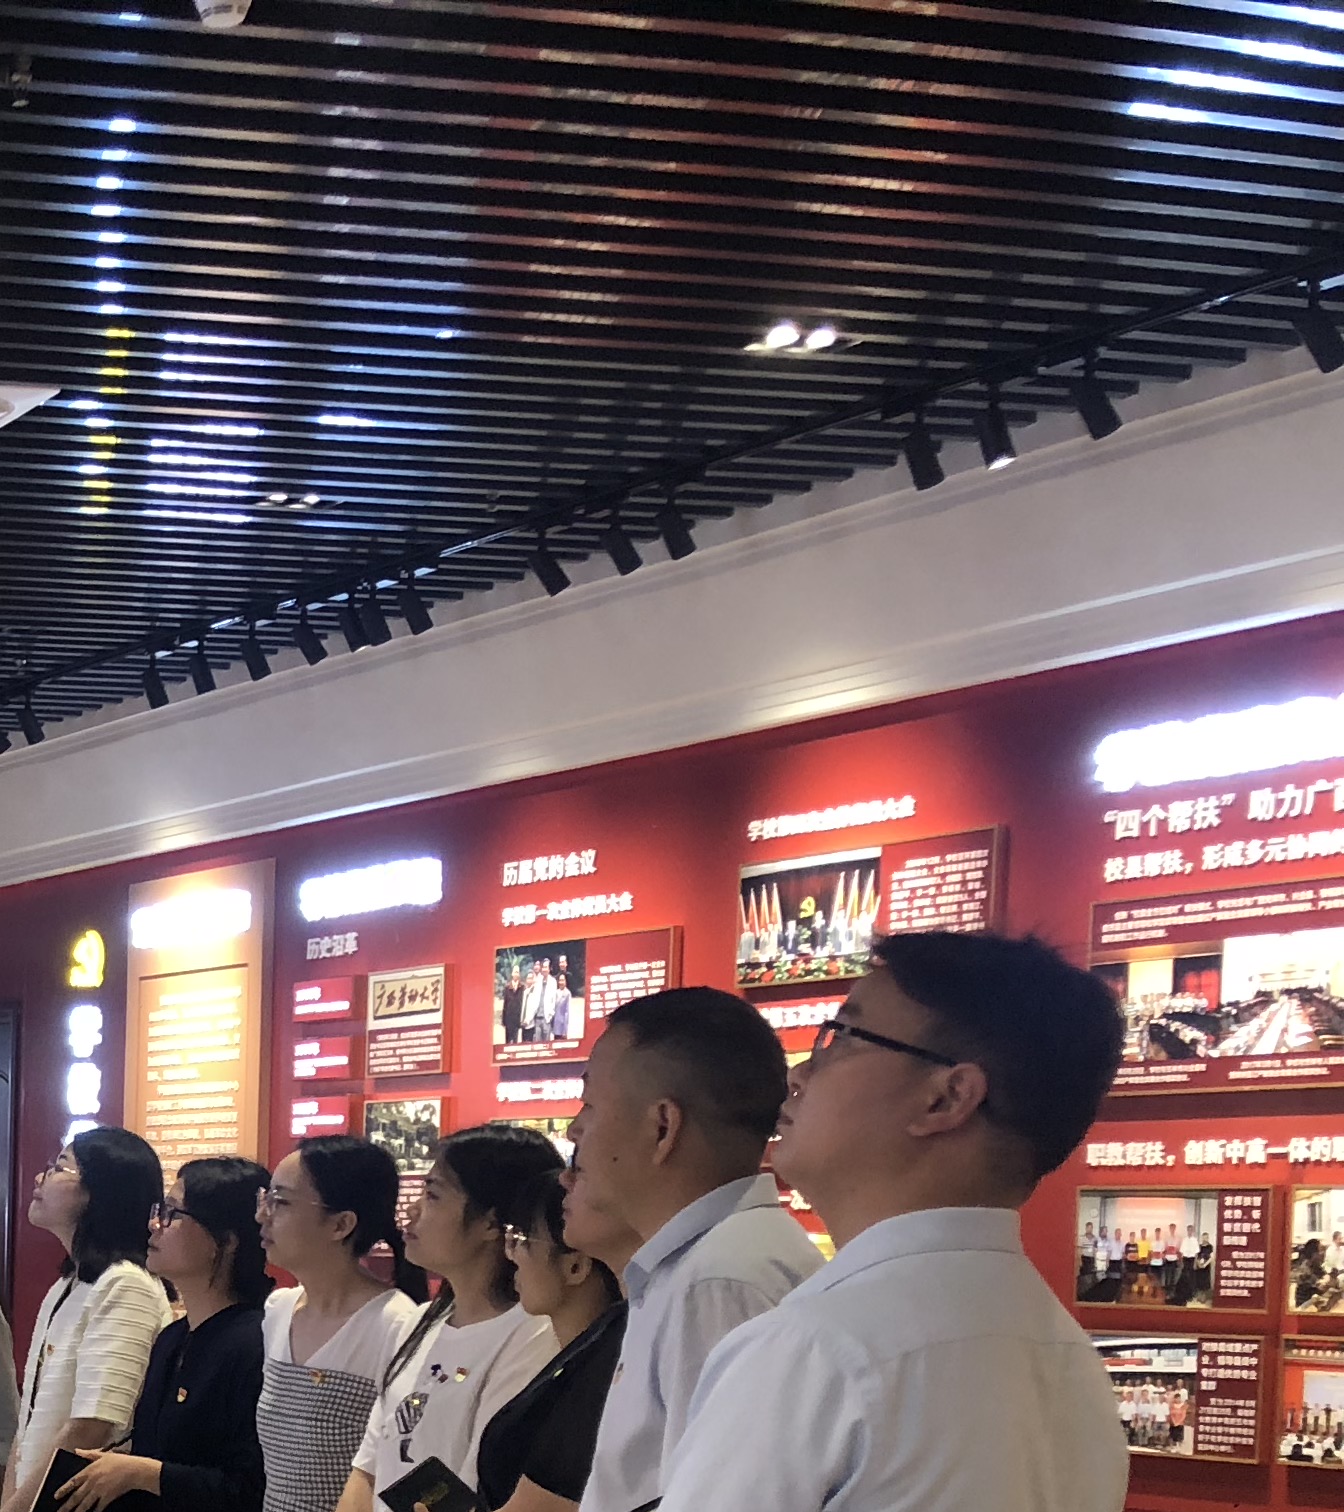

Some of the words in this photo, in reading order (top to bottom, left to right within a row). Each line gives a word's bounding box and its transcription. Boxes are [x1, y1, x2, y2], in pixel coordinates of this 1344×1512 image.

[502, 849, 598, 887] 历届党的会议
[306, 932, 359, 960] 历史沿革
